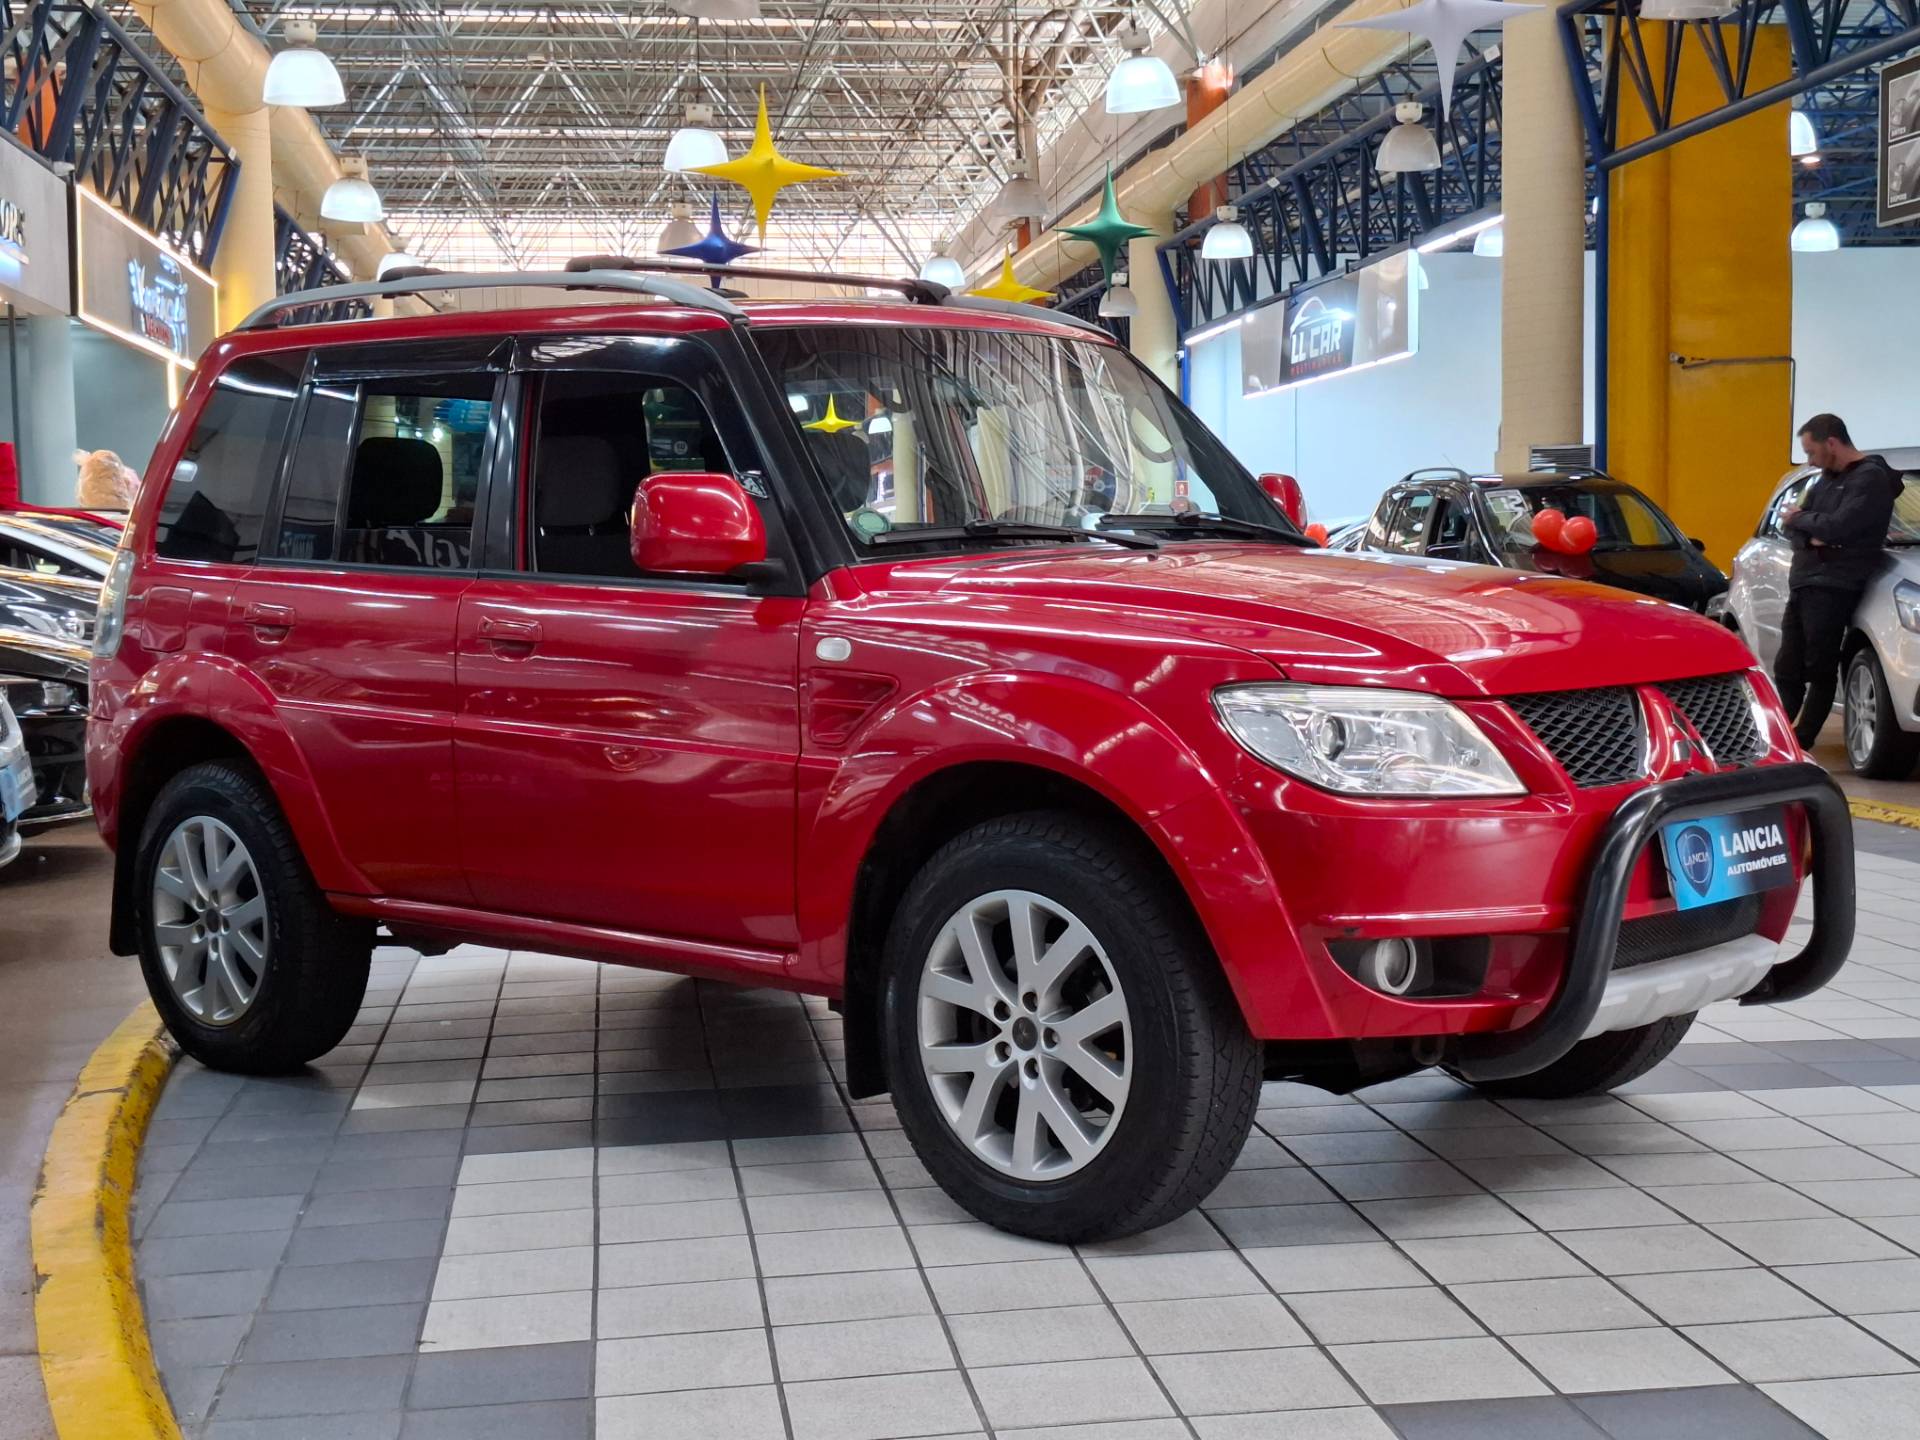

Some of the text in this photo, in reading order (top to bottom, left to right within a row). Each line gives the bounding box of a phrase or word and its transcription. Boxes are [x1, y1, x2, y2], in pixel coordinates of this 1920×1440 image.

[1291, 319, 1342, 364] LL CAR
[1720, 824, 1784, 857] LANCIA
[1682, 851, 1710, 866] LANCIA
[1727, 853, 1787, 876] AUTOMÓVEIS
